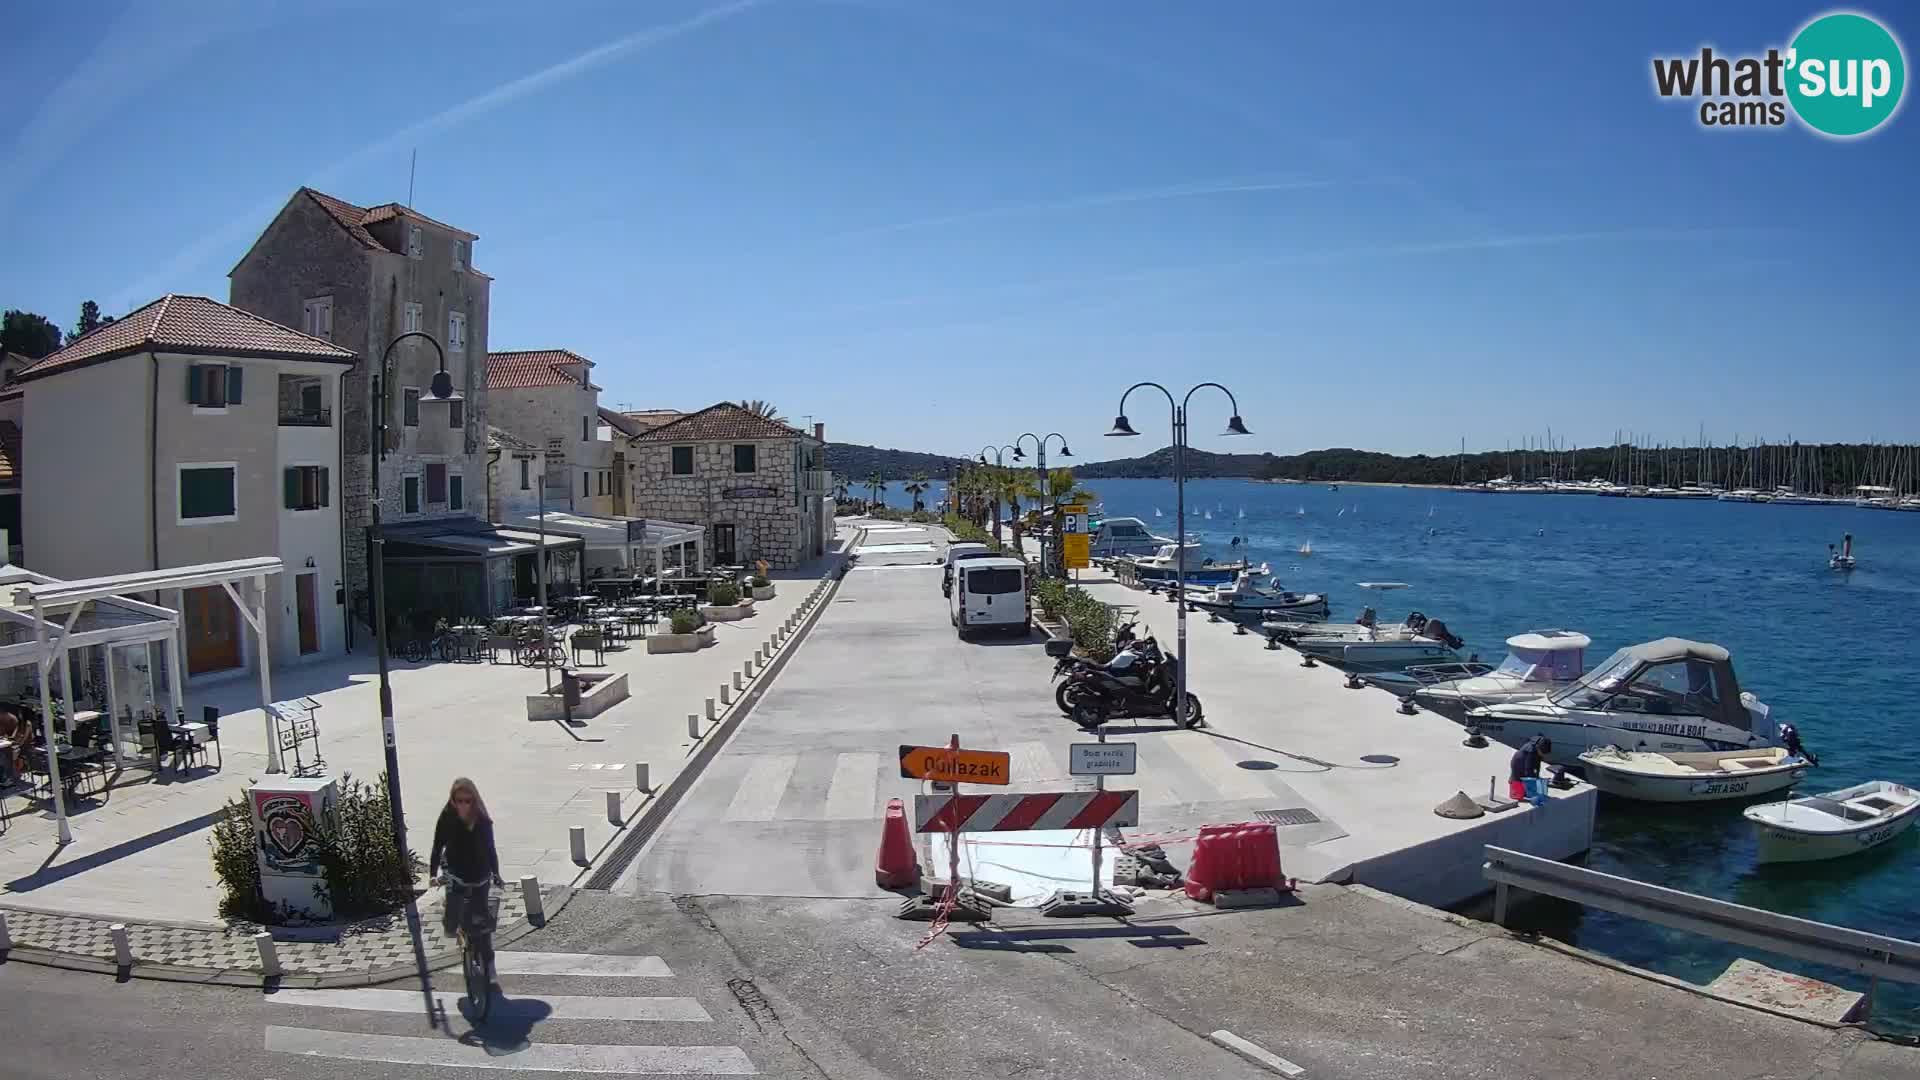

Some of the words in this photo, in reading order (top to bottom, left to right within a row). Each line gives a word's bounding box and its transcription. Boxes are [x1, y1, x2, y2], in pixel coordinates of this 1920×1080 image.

[1658, 723, 1680, 736] RENT
[1687, 725, 1708, 737] BOAT
[1729, 782, 1750, 793] BOAT
